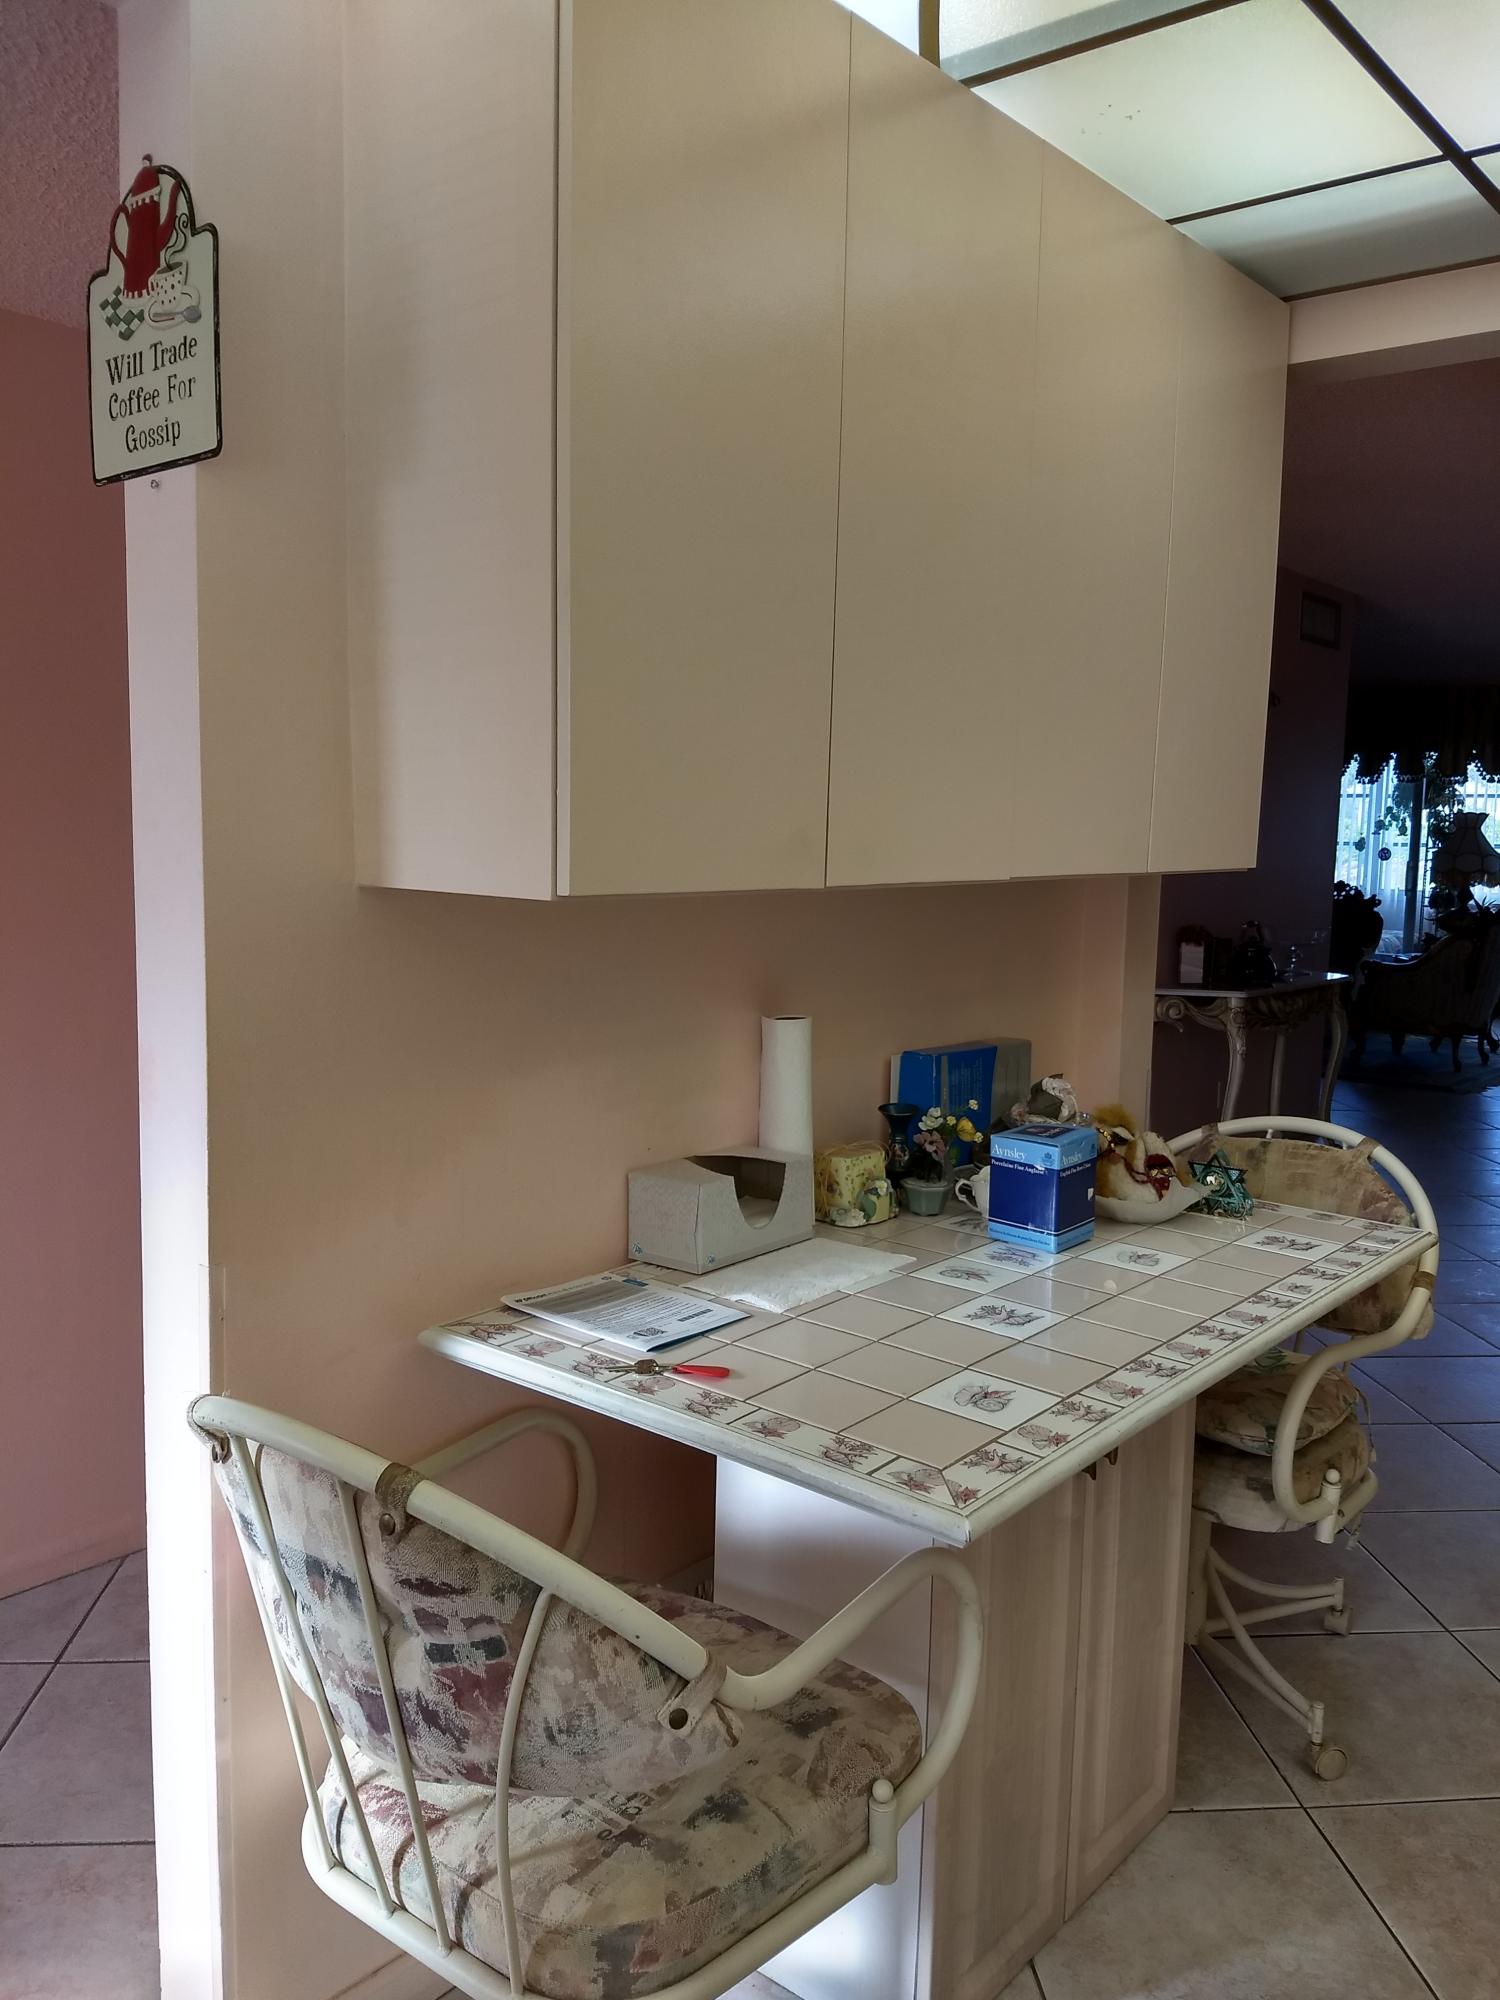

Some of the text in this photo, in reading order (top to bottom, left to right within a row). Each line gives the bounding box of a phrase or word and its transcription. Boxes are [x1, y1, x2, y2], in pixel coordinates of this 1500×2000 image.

[105, 335, 198, 386] Will Trade
[109, 373, 196, 421] Coffee For
[125, 416, 181, 453] Gossip
[992, 1143, 1025, 1161] Aynsley
